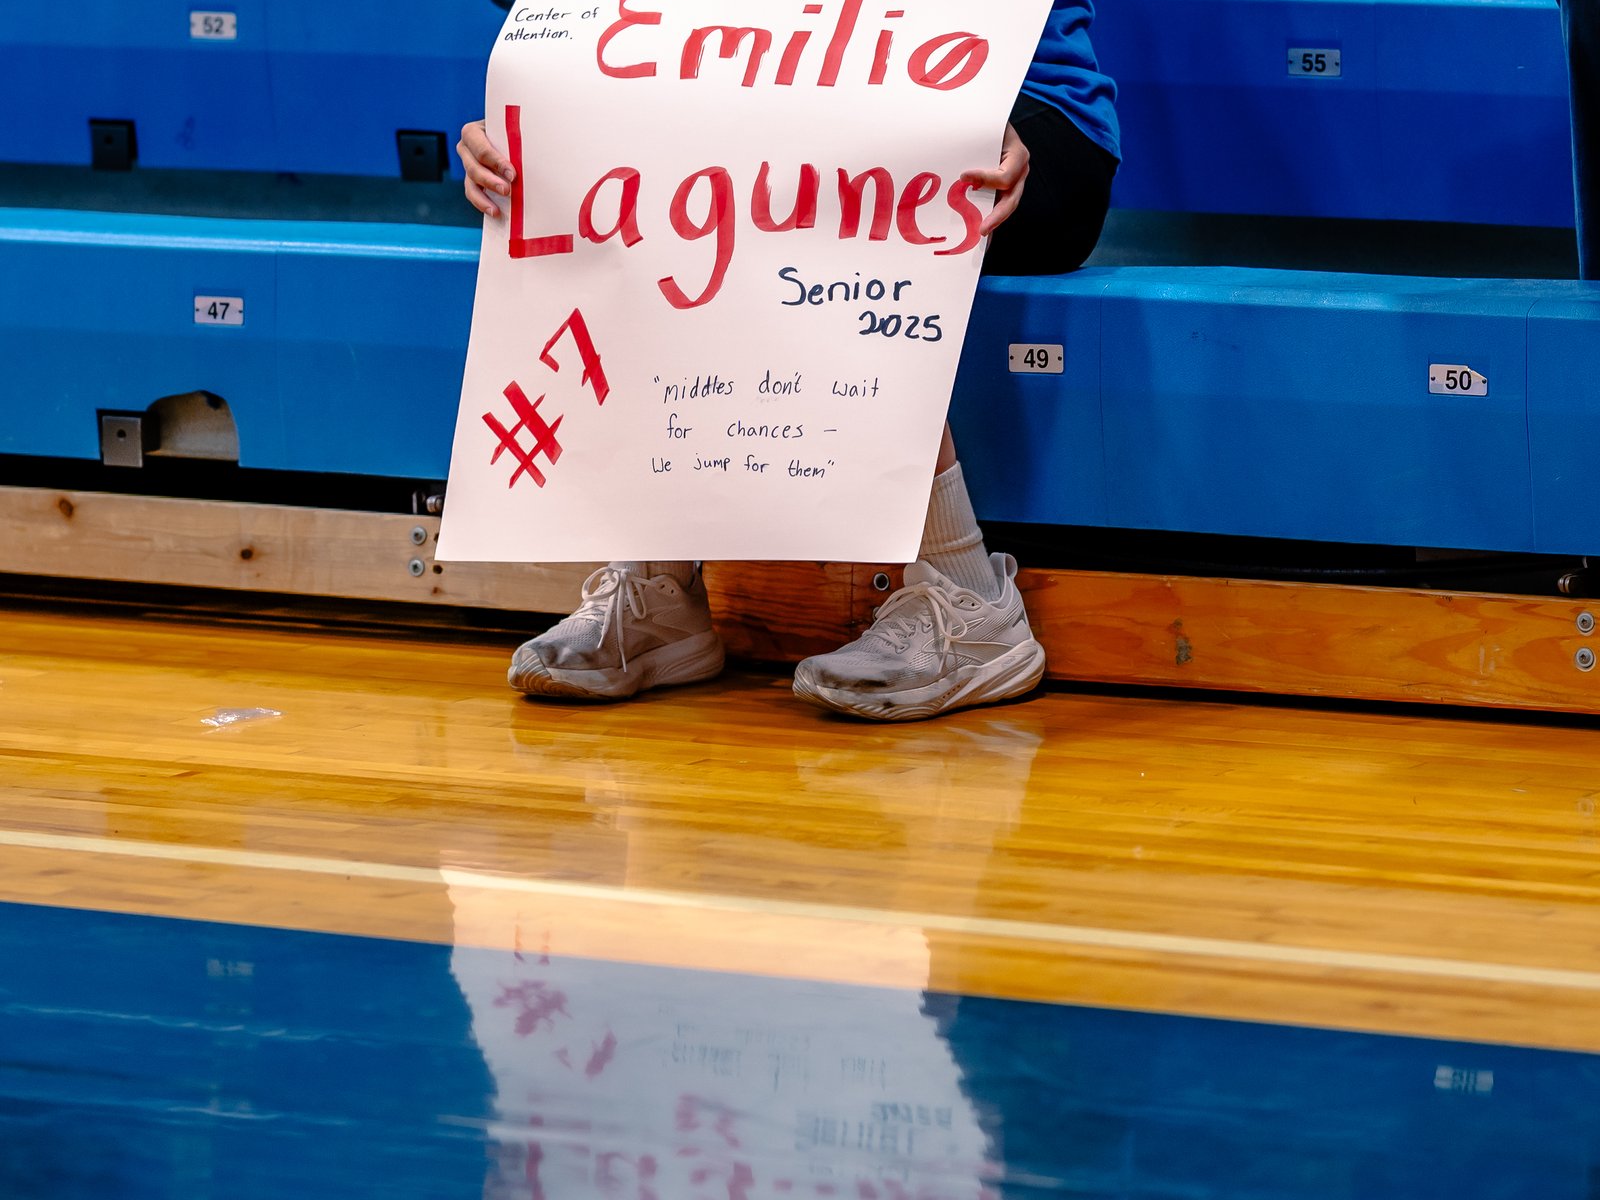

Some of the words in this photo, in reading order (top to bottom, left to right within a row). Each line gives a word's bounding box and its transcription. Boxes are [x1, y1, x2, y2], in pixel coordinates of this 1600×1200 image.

[515, 7, 571, 22] Center
[581, 7, 599, 19] of
[203, 15, 224, 35] 52
[504, 28, 573, 41] attention.
[1302, 53, 1326, 72] 55
[504, 104, 985, 310] Lagunes
[778, 267, 912, 306] Senior
[208, 301, 230, 320] 47
[858, 310, 943, 343] 2025
[1024, 348, 1049, 368] 49
[758, 369, 802, 395] don't
[1445, 370, 1472, 390] 50
[481, 307, 610, 489] #7
[667, 412, 693, 439] for
[727, 420, 803, 439] chances
[694, 453, 731, 472] jump
[744, 455, 770, 473] for
